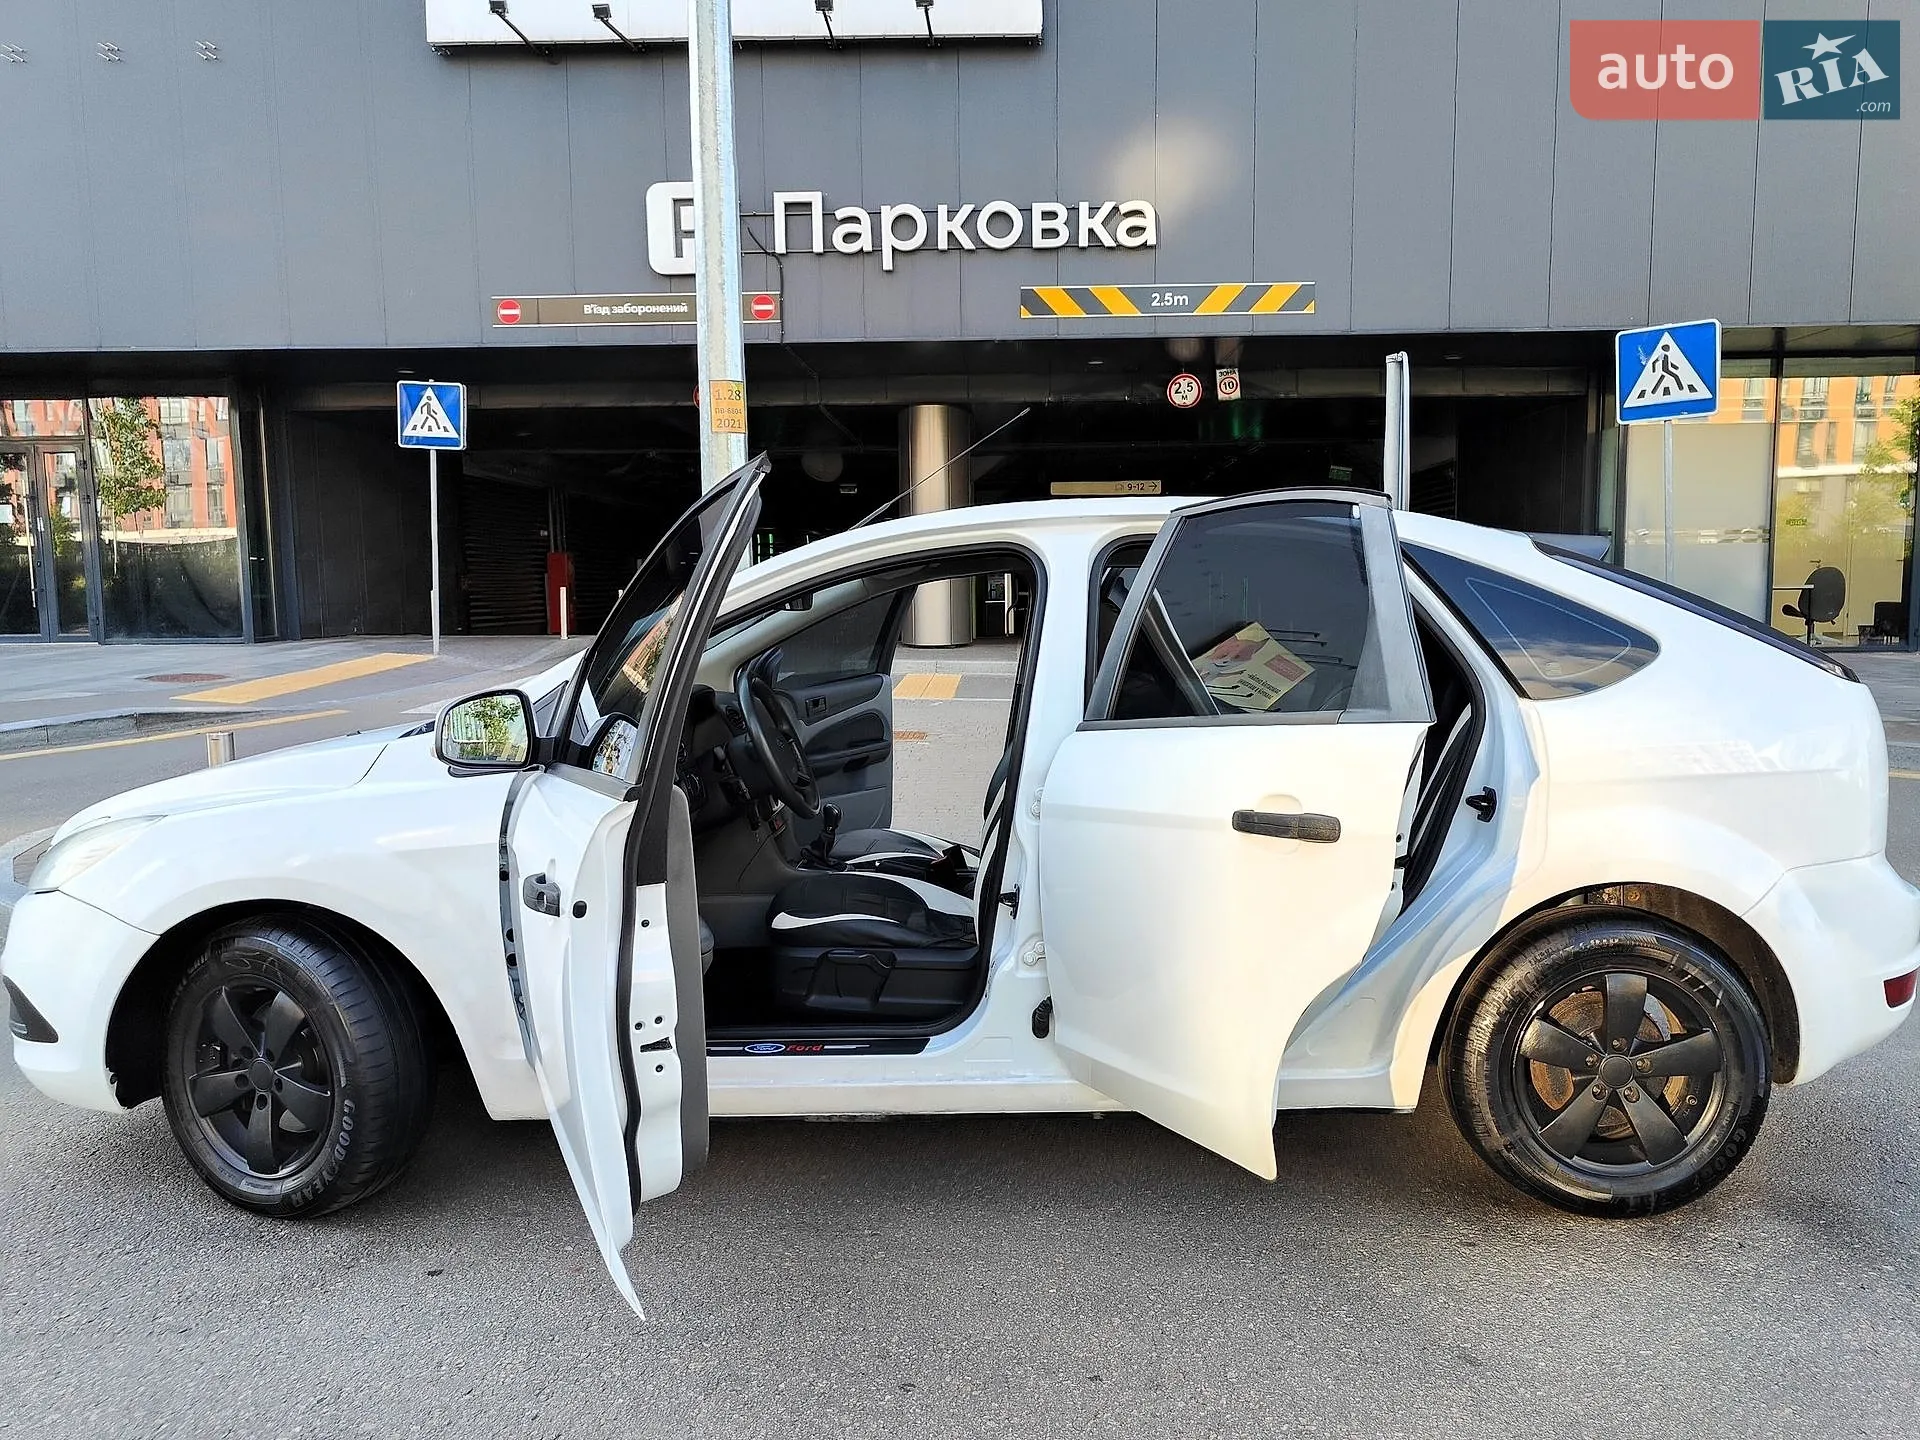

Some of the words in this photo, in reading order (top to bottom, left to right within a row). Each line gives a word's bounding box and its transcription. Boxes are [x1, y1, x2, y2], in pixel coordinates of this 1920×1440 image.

[772, 190, 1158, 271] Парковка
[1151, 292, 1189, 307] 2.5m
[612, 302, 689, 315] заборонений
[1218, 369, 1237, 378] ЗОНА
[1174, 381, 1194, 395] 2,5
[1222, 380, 1235, 391] 10
[715, 389, 741, 401] 1.28
[716, 418, 743, 429] 2021
[1127, 482, 1145, 491] 9-12
[786, 1044, 823, 1052] Ford
